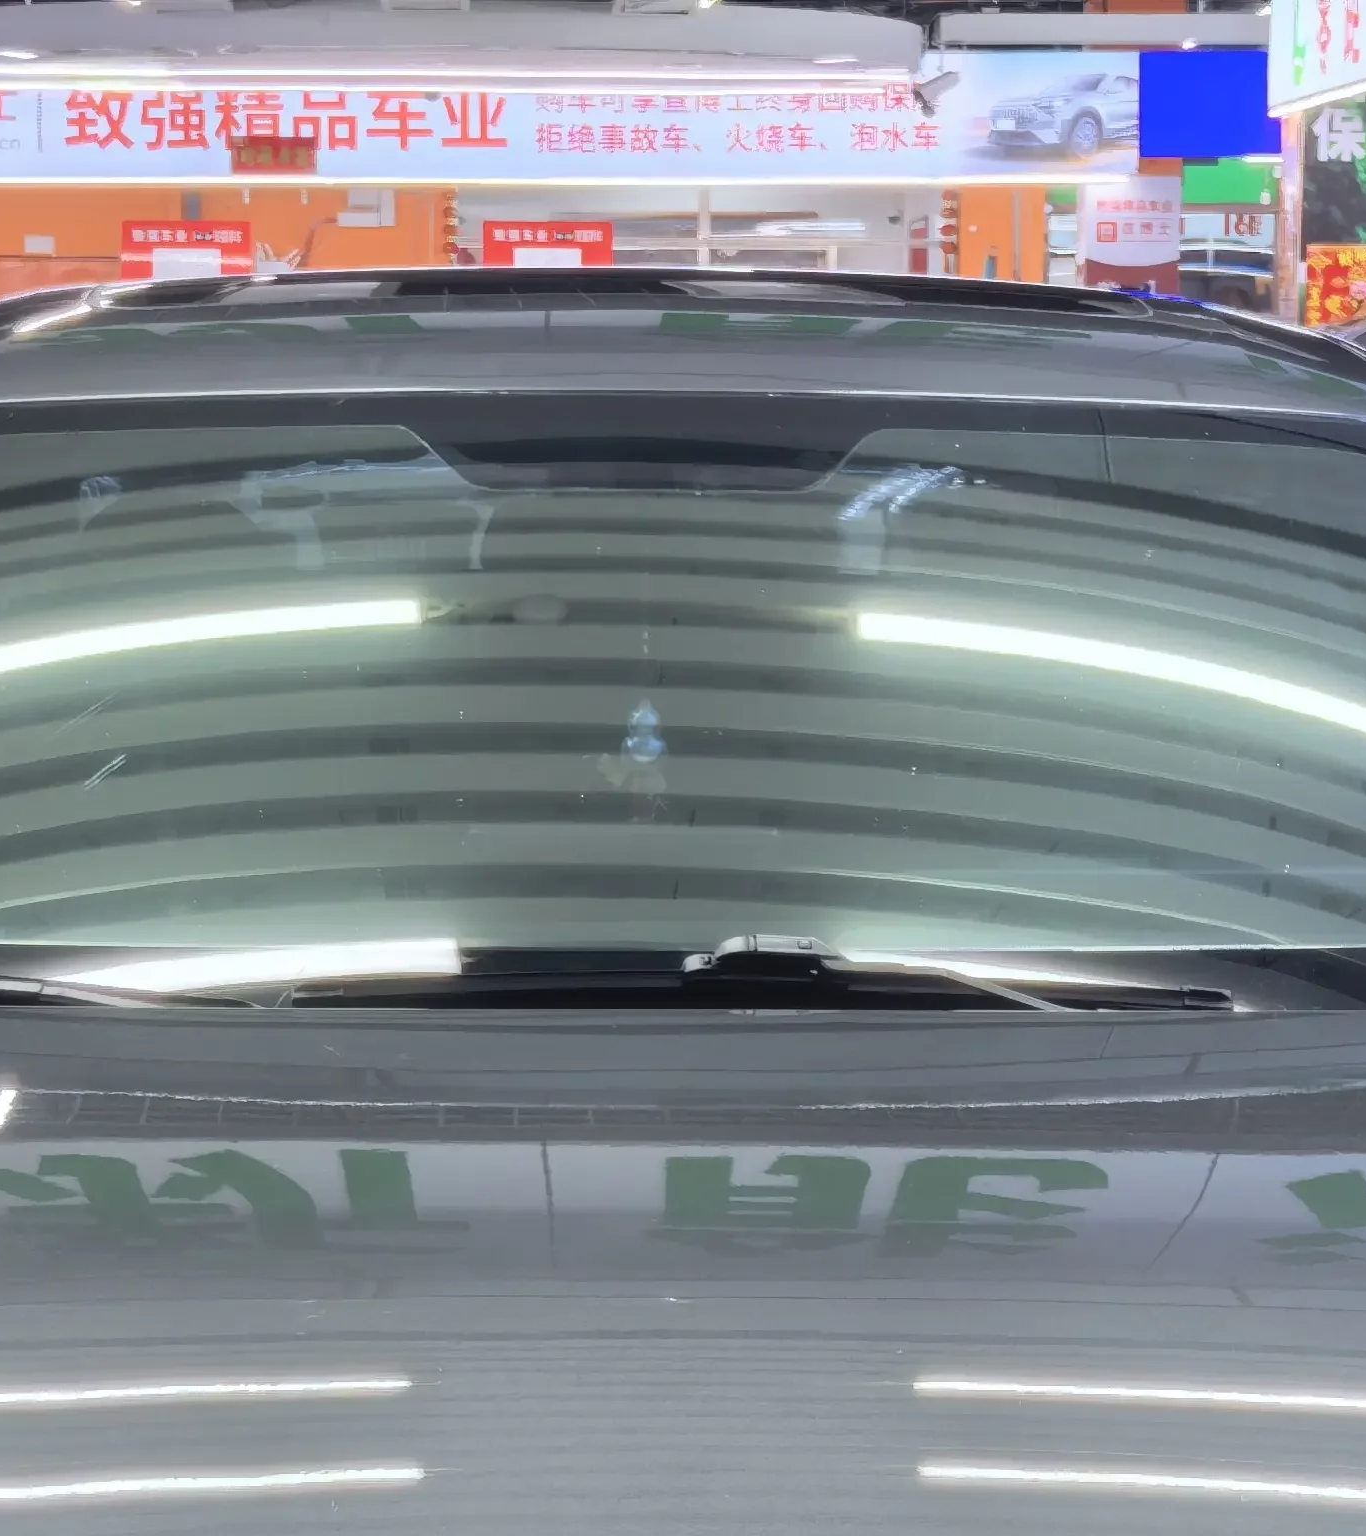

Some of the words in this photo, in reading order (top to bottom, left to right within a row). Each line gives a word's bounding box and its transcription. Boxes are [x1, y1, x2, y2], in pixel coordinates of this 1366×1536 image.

[65, 91, 508, 150] 致强精品车业
